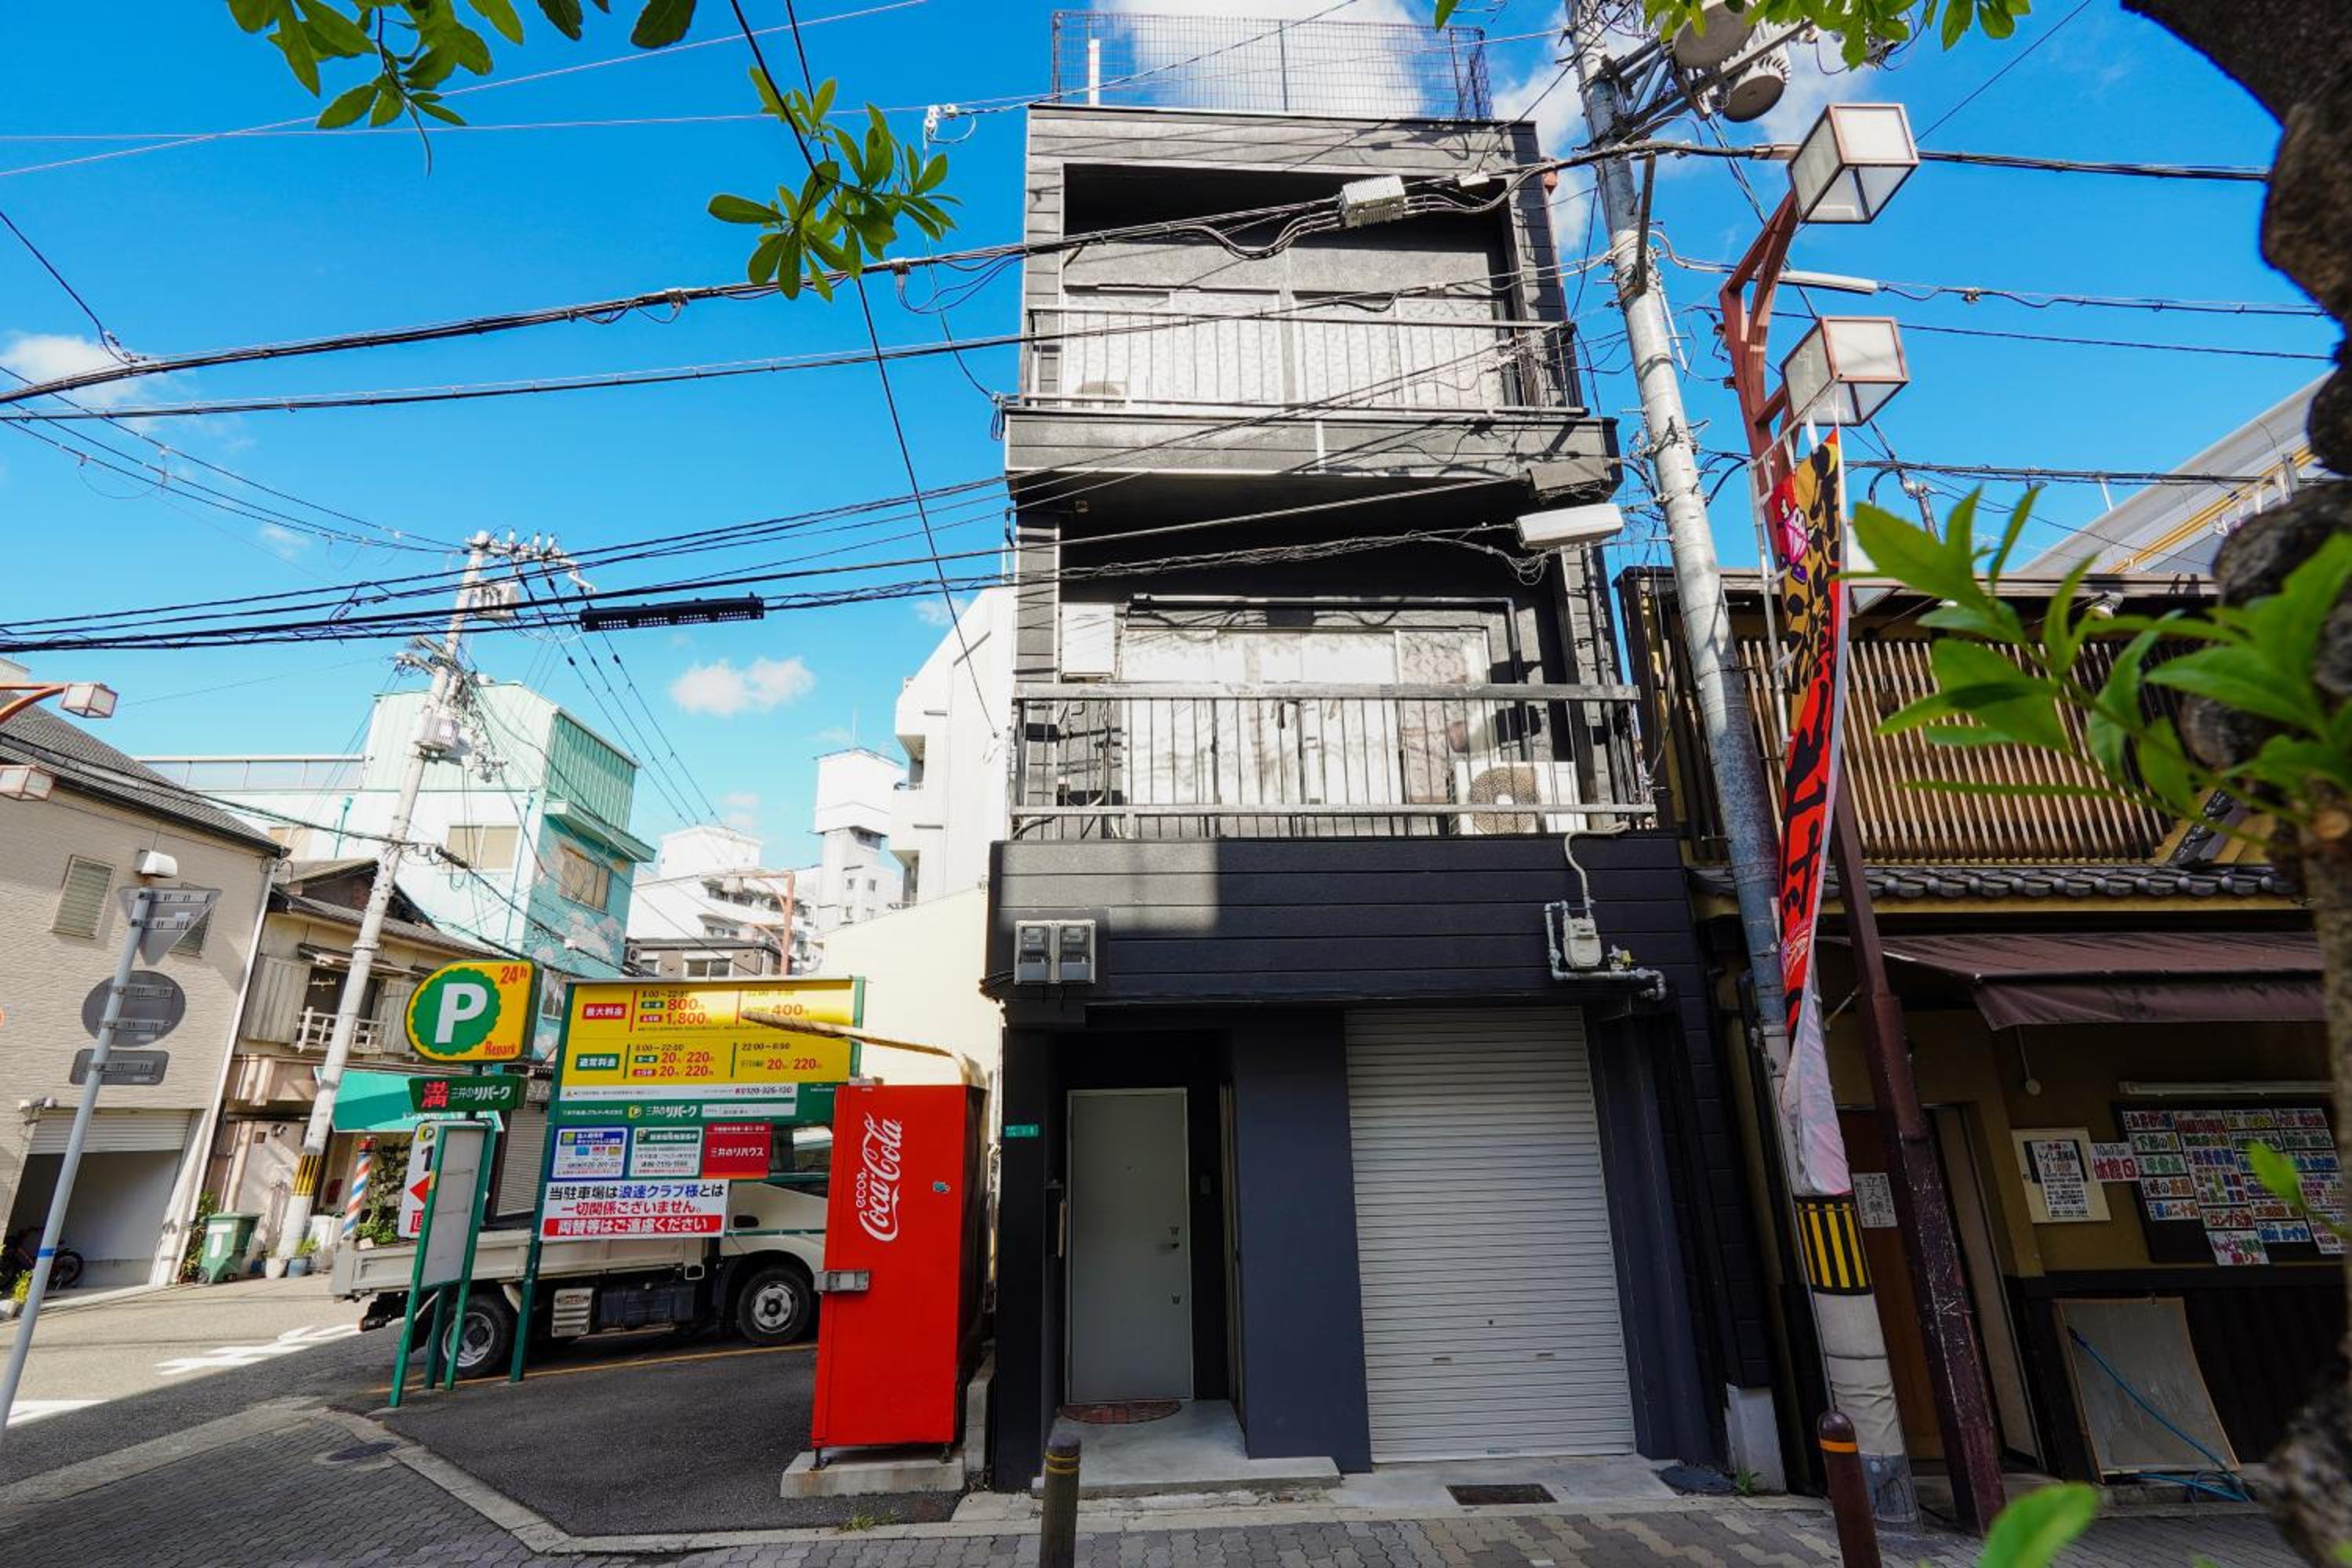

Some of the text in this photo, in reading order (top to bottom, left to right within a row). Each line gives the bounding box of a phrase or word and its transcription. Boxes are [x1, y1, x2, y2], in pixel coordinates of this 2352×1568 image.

[500, 966, 528, 985] 24h
[435, 982, 488, 1044] P
[585, 1007, 624, 1017] 最大料金
[485, 1041, 516, 1056] Repark
[578, 1057, 618, 1068] 通常料金
[422, 1081, 449, 1108] 満
[451, 1085, 511, 1101] 三井のリパーク
[645, 1105, 698, 1118] 三井のリパーク
[710, 1147, 764, 1158] 三井のリハウス
[549, 1184, 724, 1200] 当駐車場は浪速クラブ様とは
[561, 1200, 702, 1216] 一切関係ございません。
[557, 1218, 707, 1235] 両替等はご遠慮ください
